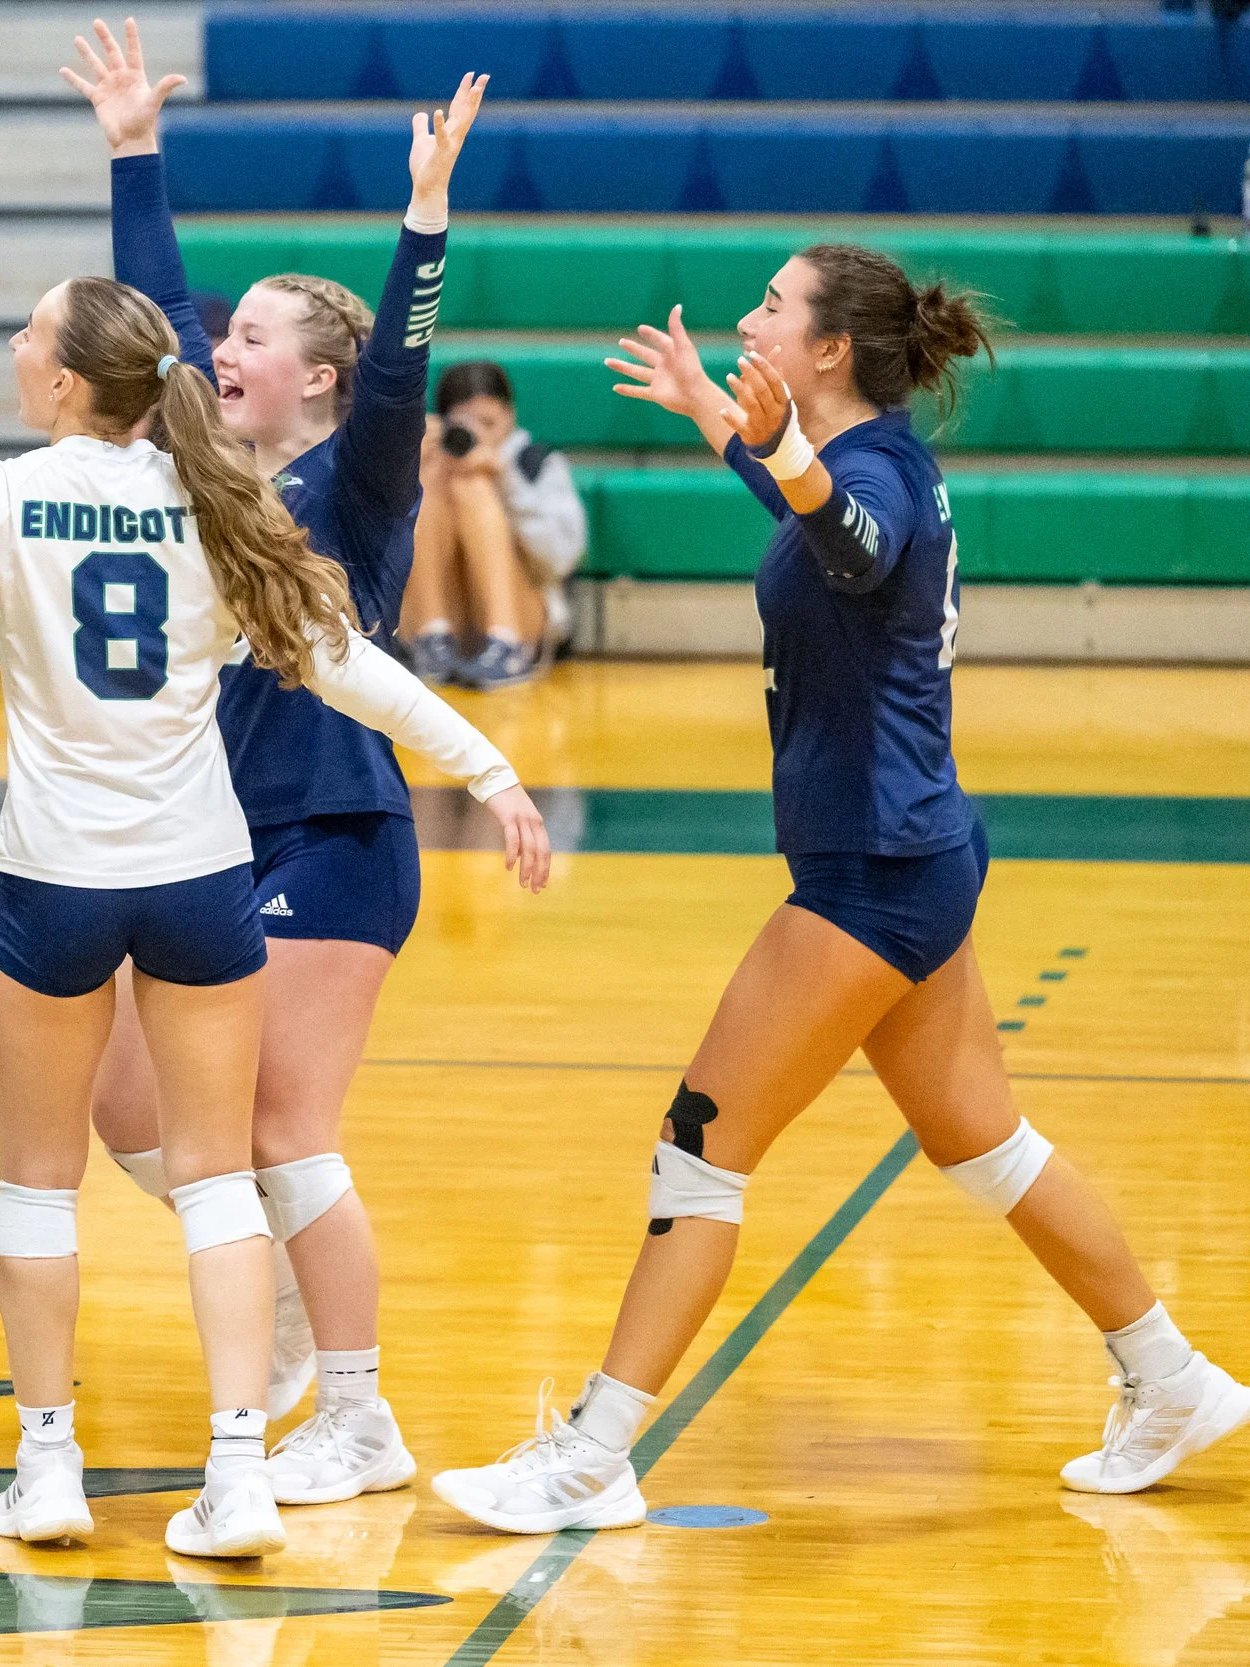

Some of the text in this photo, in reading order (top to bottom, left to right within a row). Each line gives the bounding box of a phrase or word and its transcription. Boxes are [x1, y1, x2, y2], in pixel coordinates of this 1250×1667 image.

[21, 500, 198, 544] ENDICOT
[71, 551, 169, 700] 8
[259, 906, 293, 917] adidas
